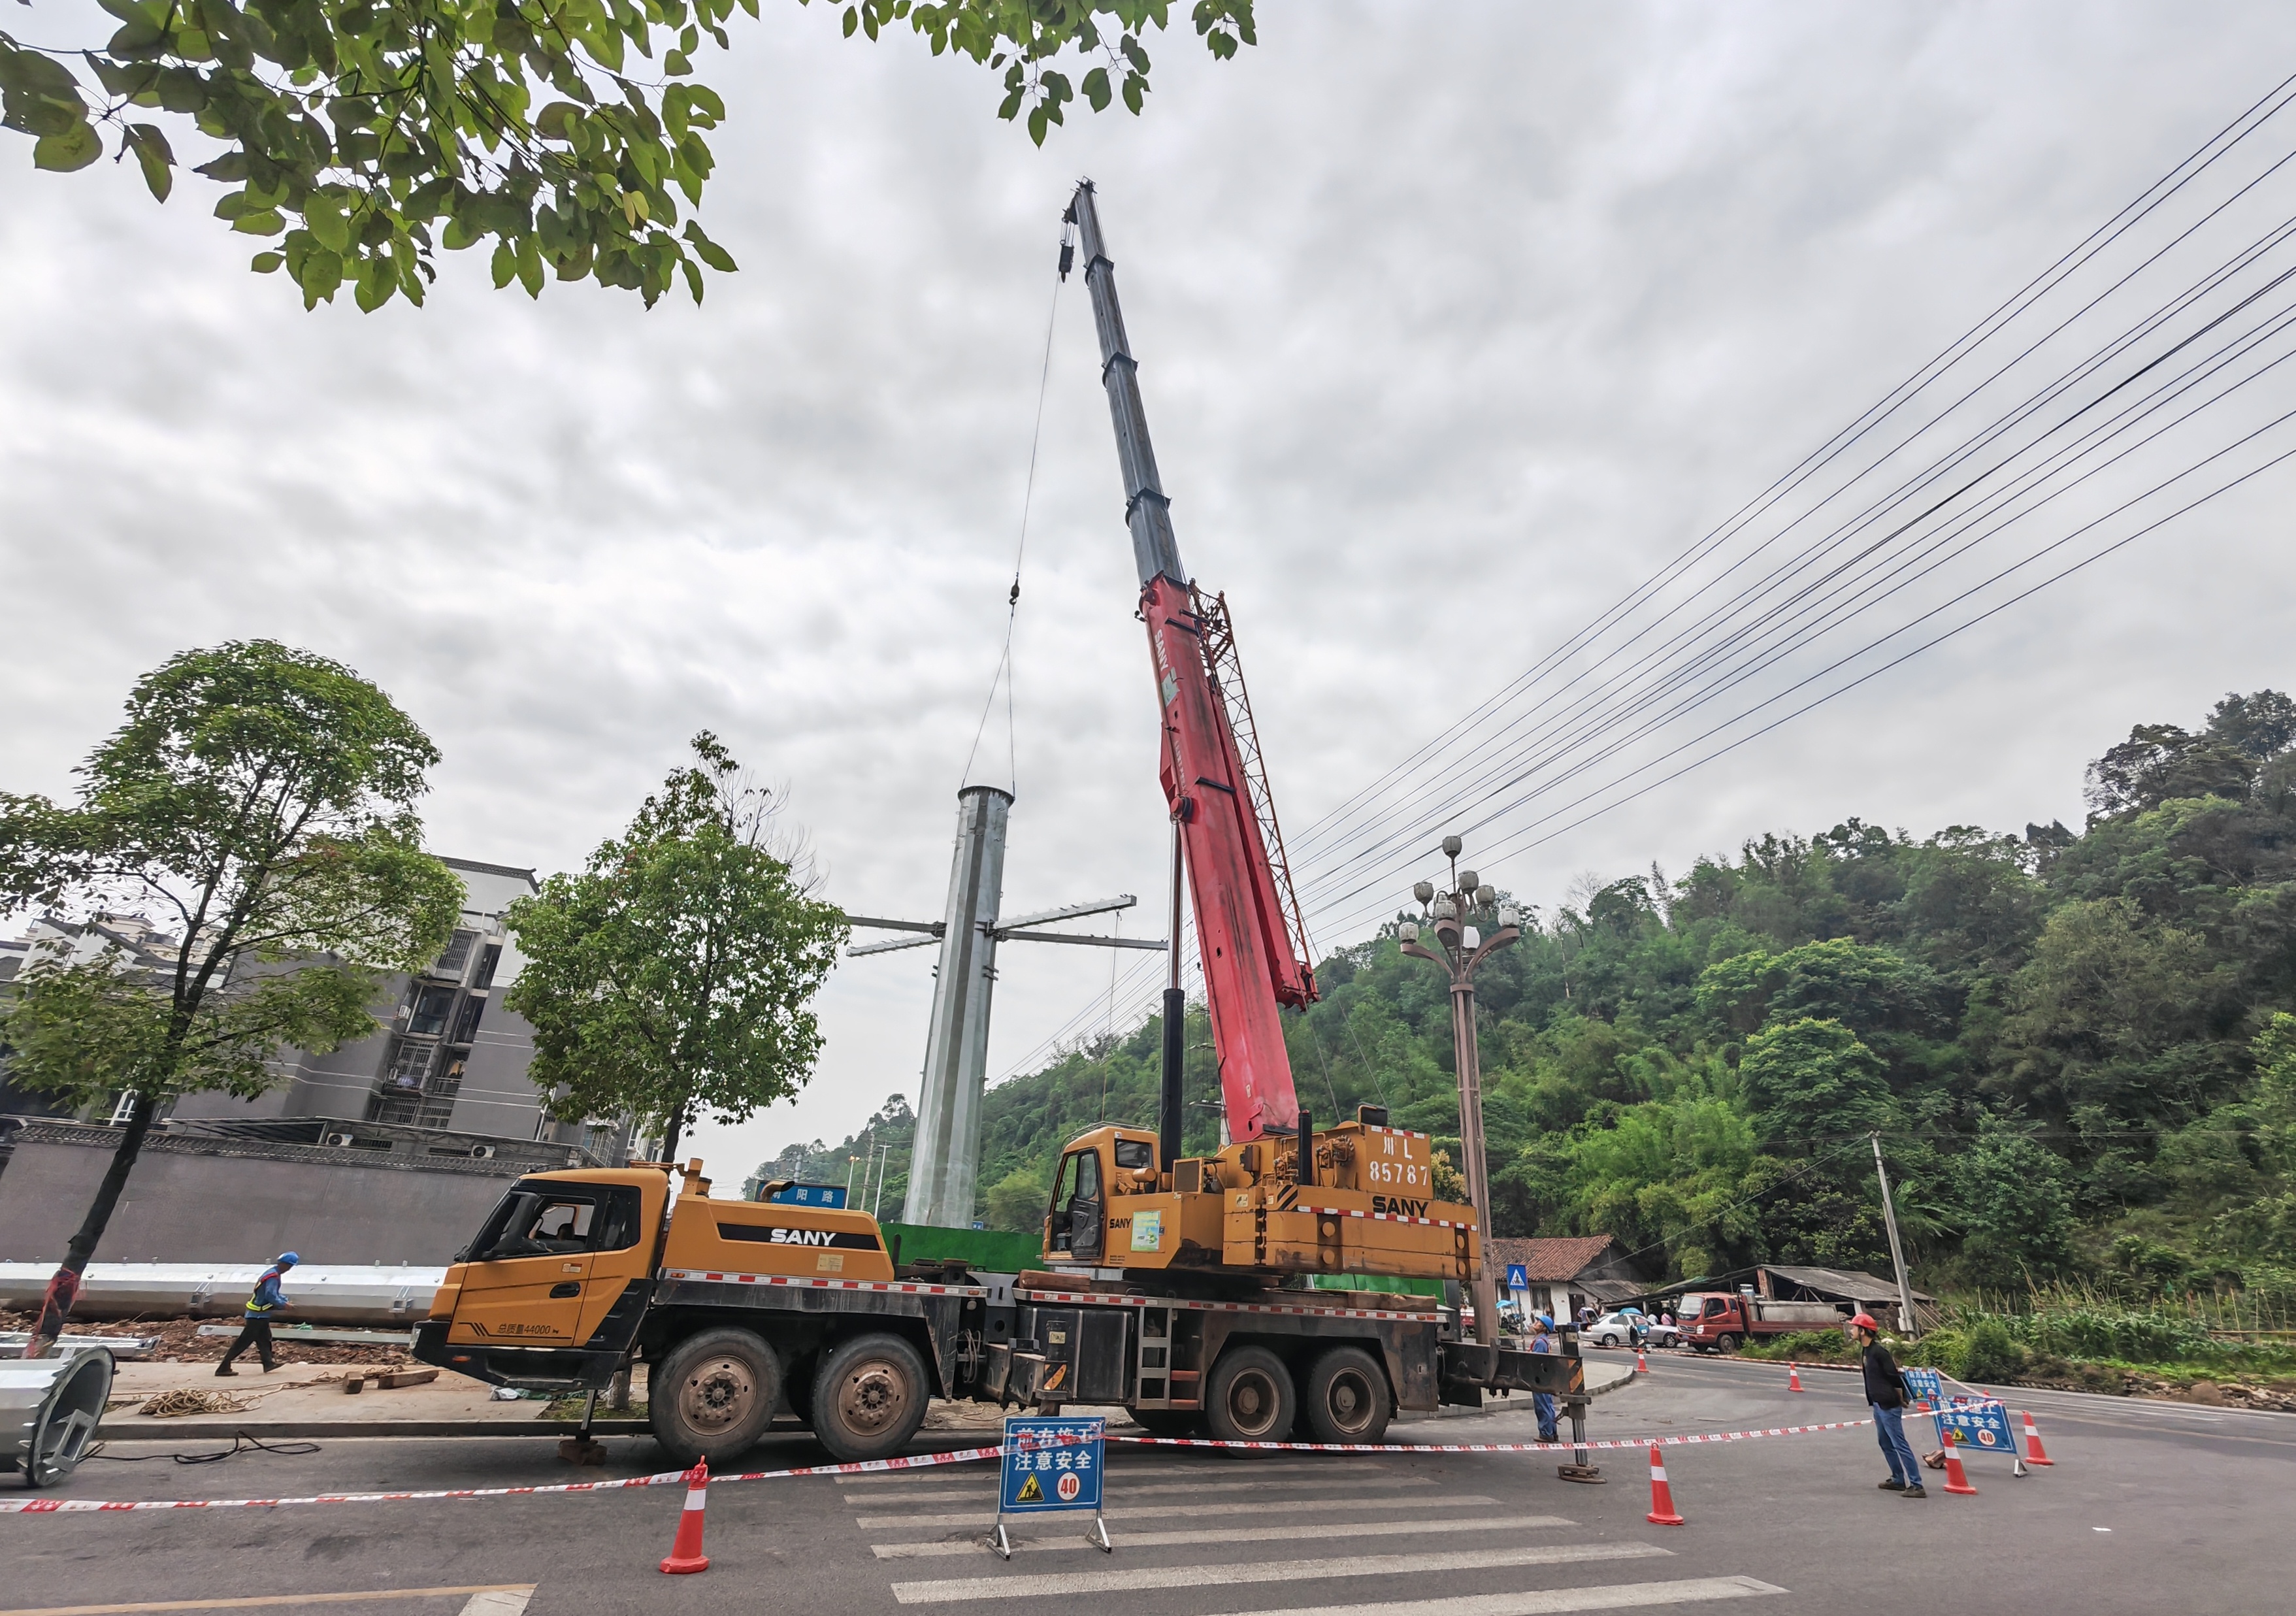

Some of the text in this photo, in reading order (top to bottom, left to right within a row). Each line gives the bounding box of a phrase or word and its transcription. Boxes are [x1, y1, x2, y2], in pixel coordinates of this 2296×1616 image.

[1155, 629, 1169, 672] SANY
[1369, 1161, 1428, 1186] 85787
[1372, 1195, 1429, 1218] SANY
[1109, 1217, 1132, 1229] SANY
[770, 1228, 837, 1246] SANY
[1941, 1413, 2001, 1430] 注意安全
[1980, 1432, 1994, 1443] 40
[1015, 1449, 1092, 1471] 注意安全
[1060, 1478, 1077, 1494] 40
